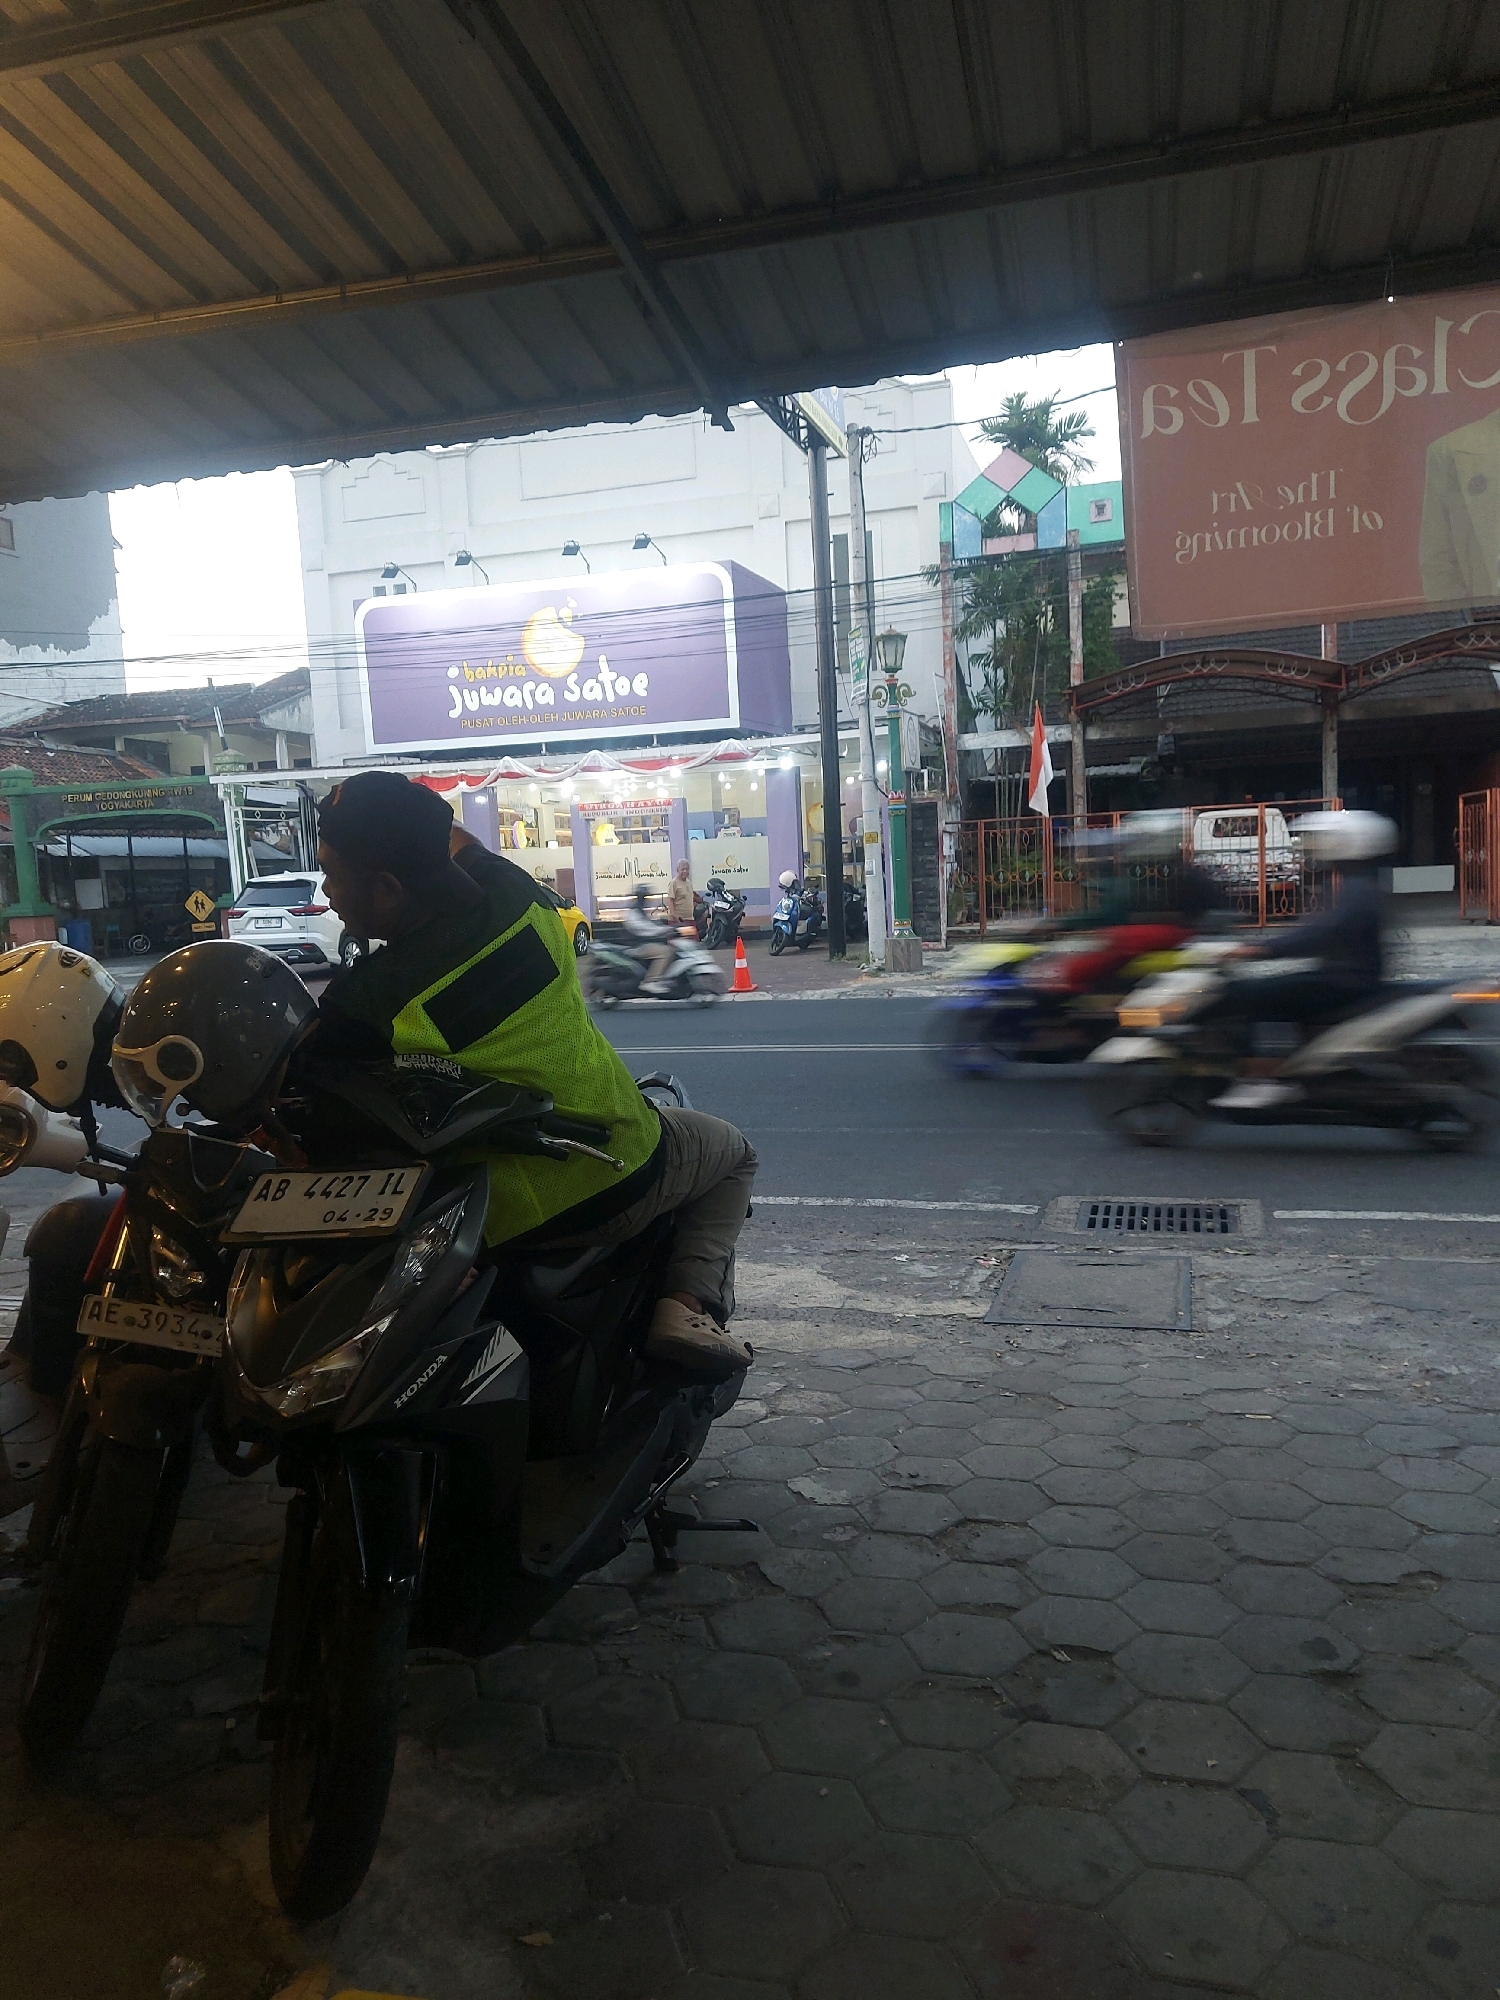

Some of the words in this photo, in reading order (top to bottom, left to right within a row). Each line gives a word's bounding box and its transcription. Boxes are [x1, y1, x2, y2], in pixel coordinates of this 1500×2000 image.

[462, 653, 527, 683] bakpia
[460, 717, 495, 729] PUSAT
[497, 711, 559, 727] OLEH-OLEH
[561, 708, 608, 722] JUWARA
[610, 705, 647, 718] SATOE
[61, 793, 93, 803] PERUM
[94, 787, 165, 801] GEDONGKUNING
[95, 799, 155, 811] YOGYAKARTA
[254, 1178, 291, 1202] AB
[303, 1175, 372, 1200] 4427
[378, 1172, 406, 1196] IL
[87, 1300, 121, 1325] AE
[137, 1307, 200, 1338] 3934
[394, 1354, 448, 1409] HONDA
